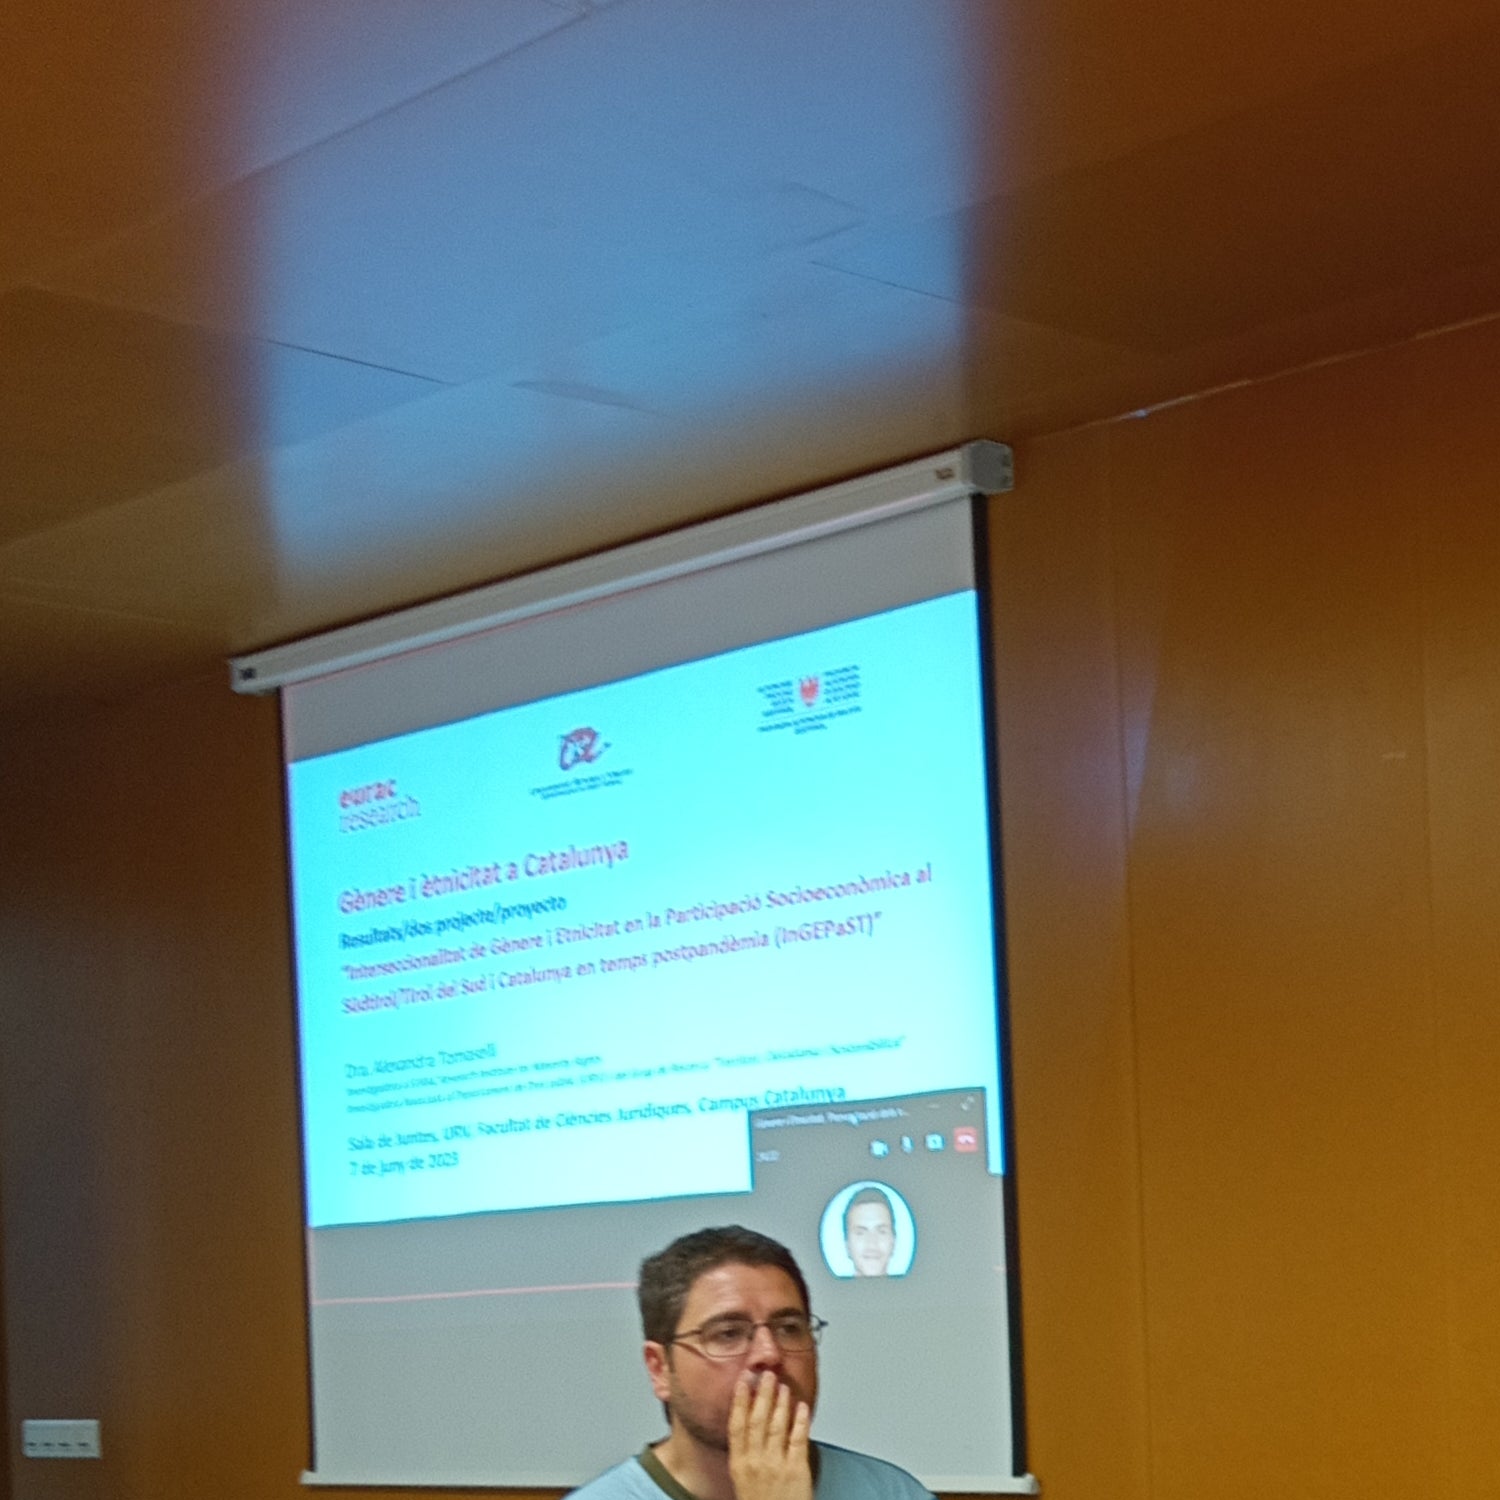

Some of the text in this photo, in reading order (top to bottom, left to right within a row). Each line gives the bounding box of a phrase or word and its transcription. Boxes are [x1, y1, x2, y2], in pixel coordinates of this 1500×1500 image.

[339, 778, 397, 808] eurac
[338, 885, 405, 914] Gènere
[409, 878, 417, 900] i
[506, 862, 519, 882] a
[523, 841, 629, 877] Catalunya
[624, 918, 643, 934] en
[649, 911, 662, 928] la
[916, 862, 932, 884] al
[498, 965, 572, 989] Catalunya
[576, 961, 595, 976] en
[600, 952, 648, 975] temps
